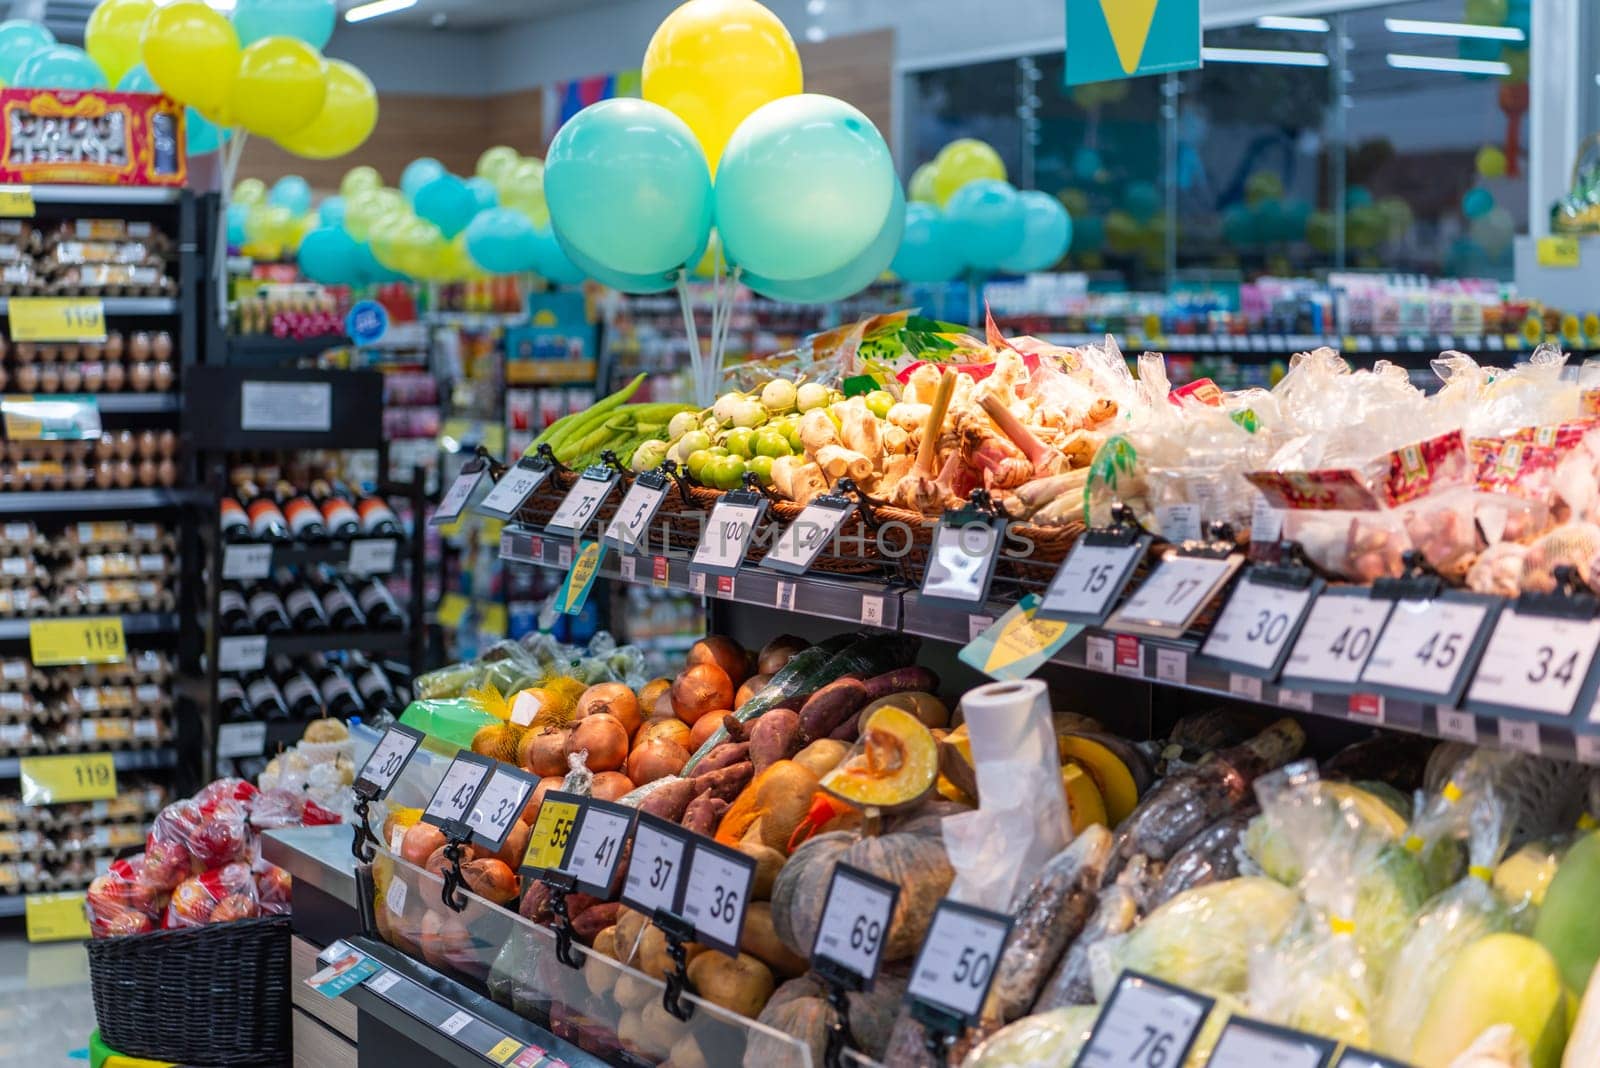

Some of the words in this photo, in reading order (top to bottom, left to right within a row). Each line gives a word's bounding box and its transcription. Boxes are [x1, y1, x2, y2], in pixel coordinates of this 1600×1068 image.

[573, 496, 596, 517] 75
[630, 504, 647, 528] 5
[725, 521, 743, 541] 100
[806, 527, 829, 551] 90
[1083, 565, 1113, 593] 15
[1166, 579, 1202, 605] 17
[84, 627, 119, 649] 119
[1247, 610, 1288, 645] 30
[1329, 627, 1371, 661] 40
[1416, 632, 1463, 669] 45
[1527, 645, 1579, 686] 34
[74, 762, 110, 788] 119
[379, 751, 403, 777] 30
[451, 782, 474, 810] 43
[490, 798, 517, 828] 32
[550, 817, 574, 850] 55
[593, 835, 617, 868] 41
[649, 855, 673, 893] 37
[710, 885, 739, 924] 36
[851, 915, 881, 955] 69
[953, 947, 992, 989] 50
[1132, 1027, 1175, 1068] 76
